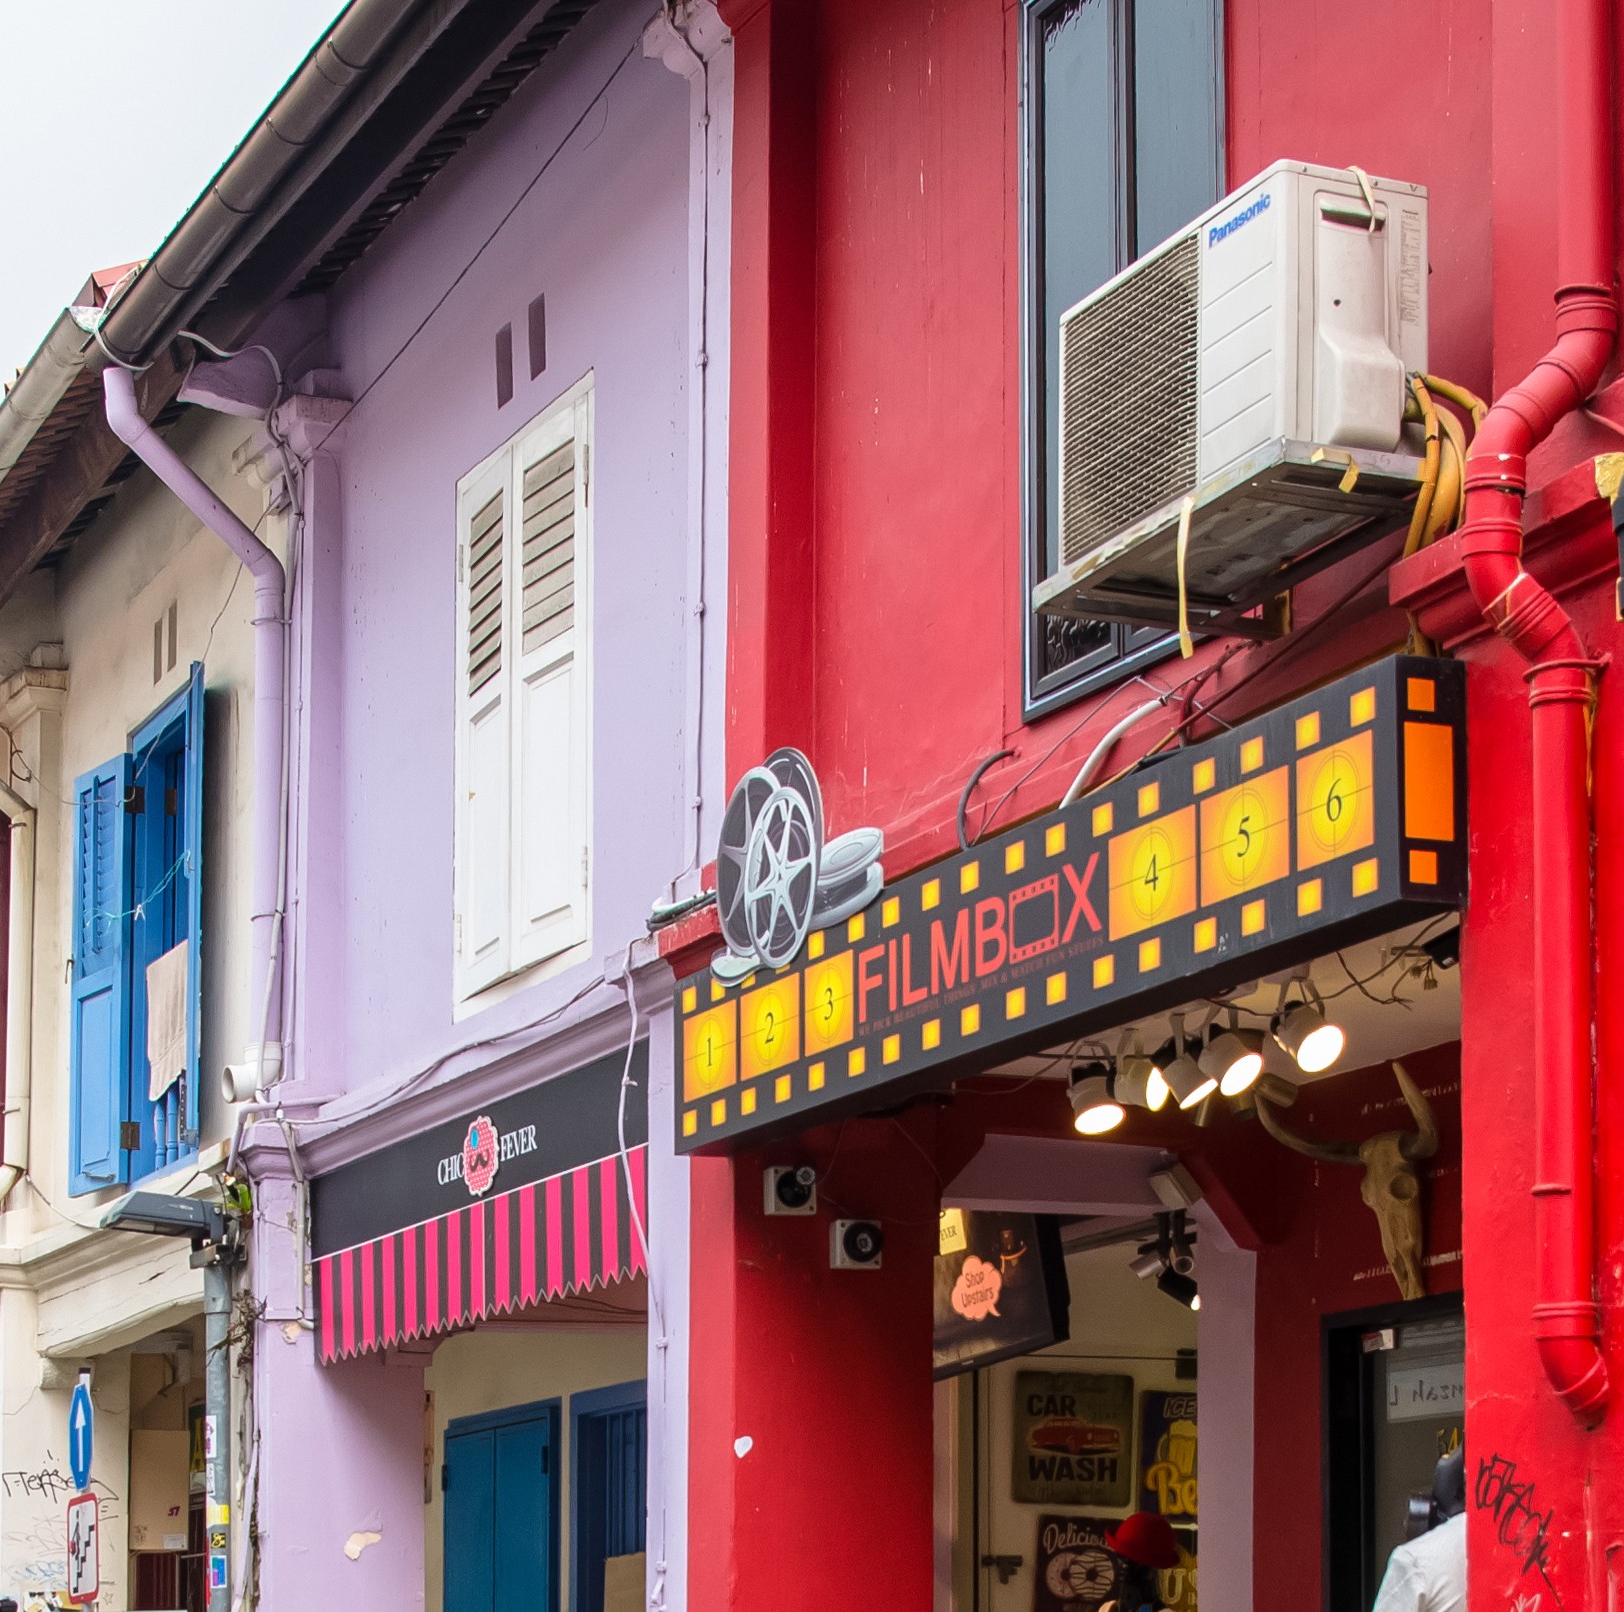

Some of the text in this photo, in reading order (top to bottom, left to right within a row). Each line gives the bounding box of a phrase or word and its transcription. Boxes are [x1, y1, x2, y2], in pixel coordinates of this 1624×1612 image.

[1209, 193, 1271, 249] Panasonic
[706, 1037, 713, 1067] 1
[764, 1012, 775, 1044] 2
[824, 987, 834, 1021] 3
[1144, 854, 1159, 891] 4
[1237, 815, 1251, 857] 5
[1326, 778, 1342, 822] 6
[438, 1124, 538, 1186] CHIC FEVER
[965, 1271, 985, 1289] Shop
[961, 1287, 994, 1308] Upstairs
[1028, 1394, 1076, 1418] CAR
[1030, 1456, 1118, 1483] WASH
